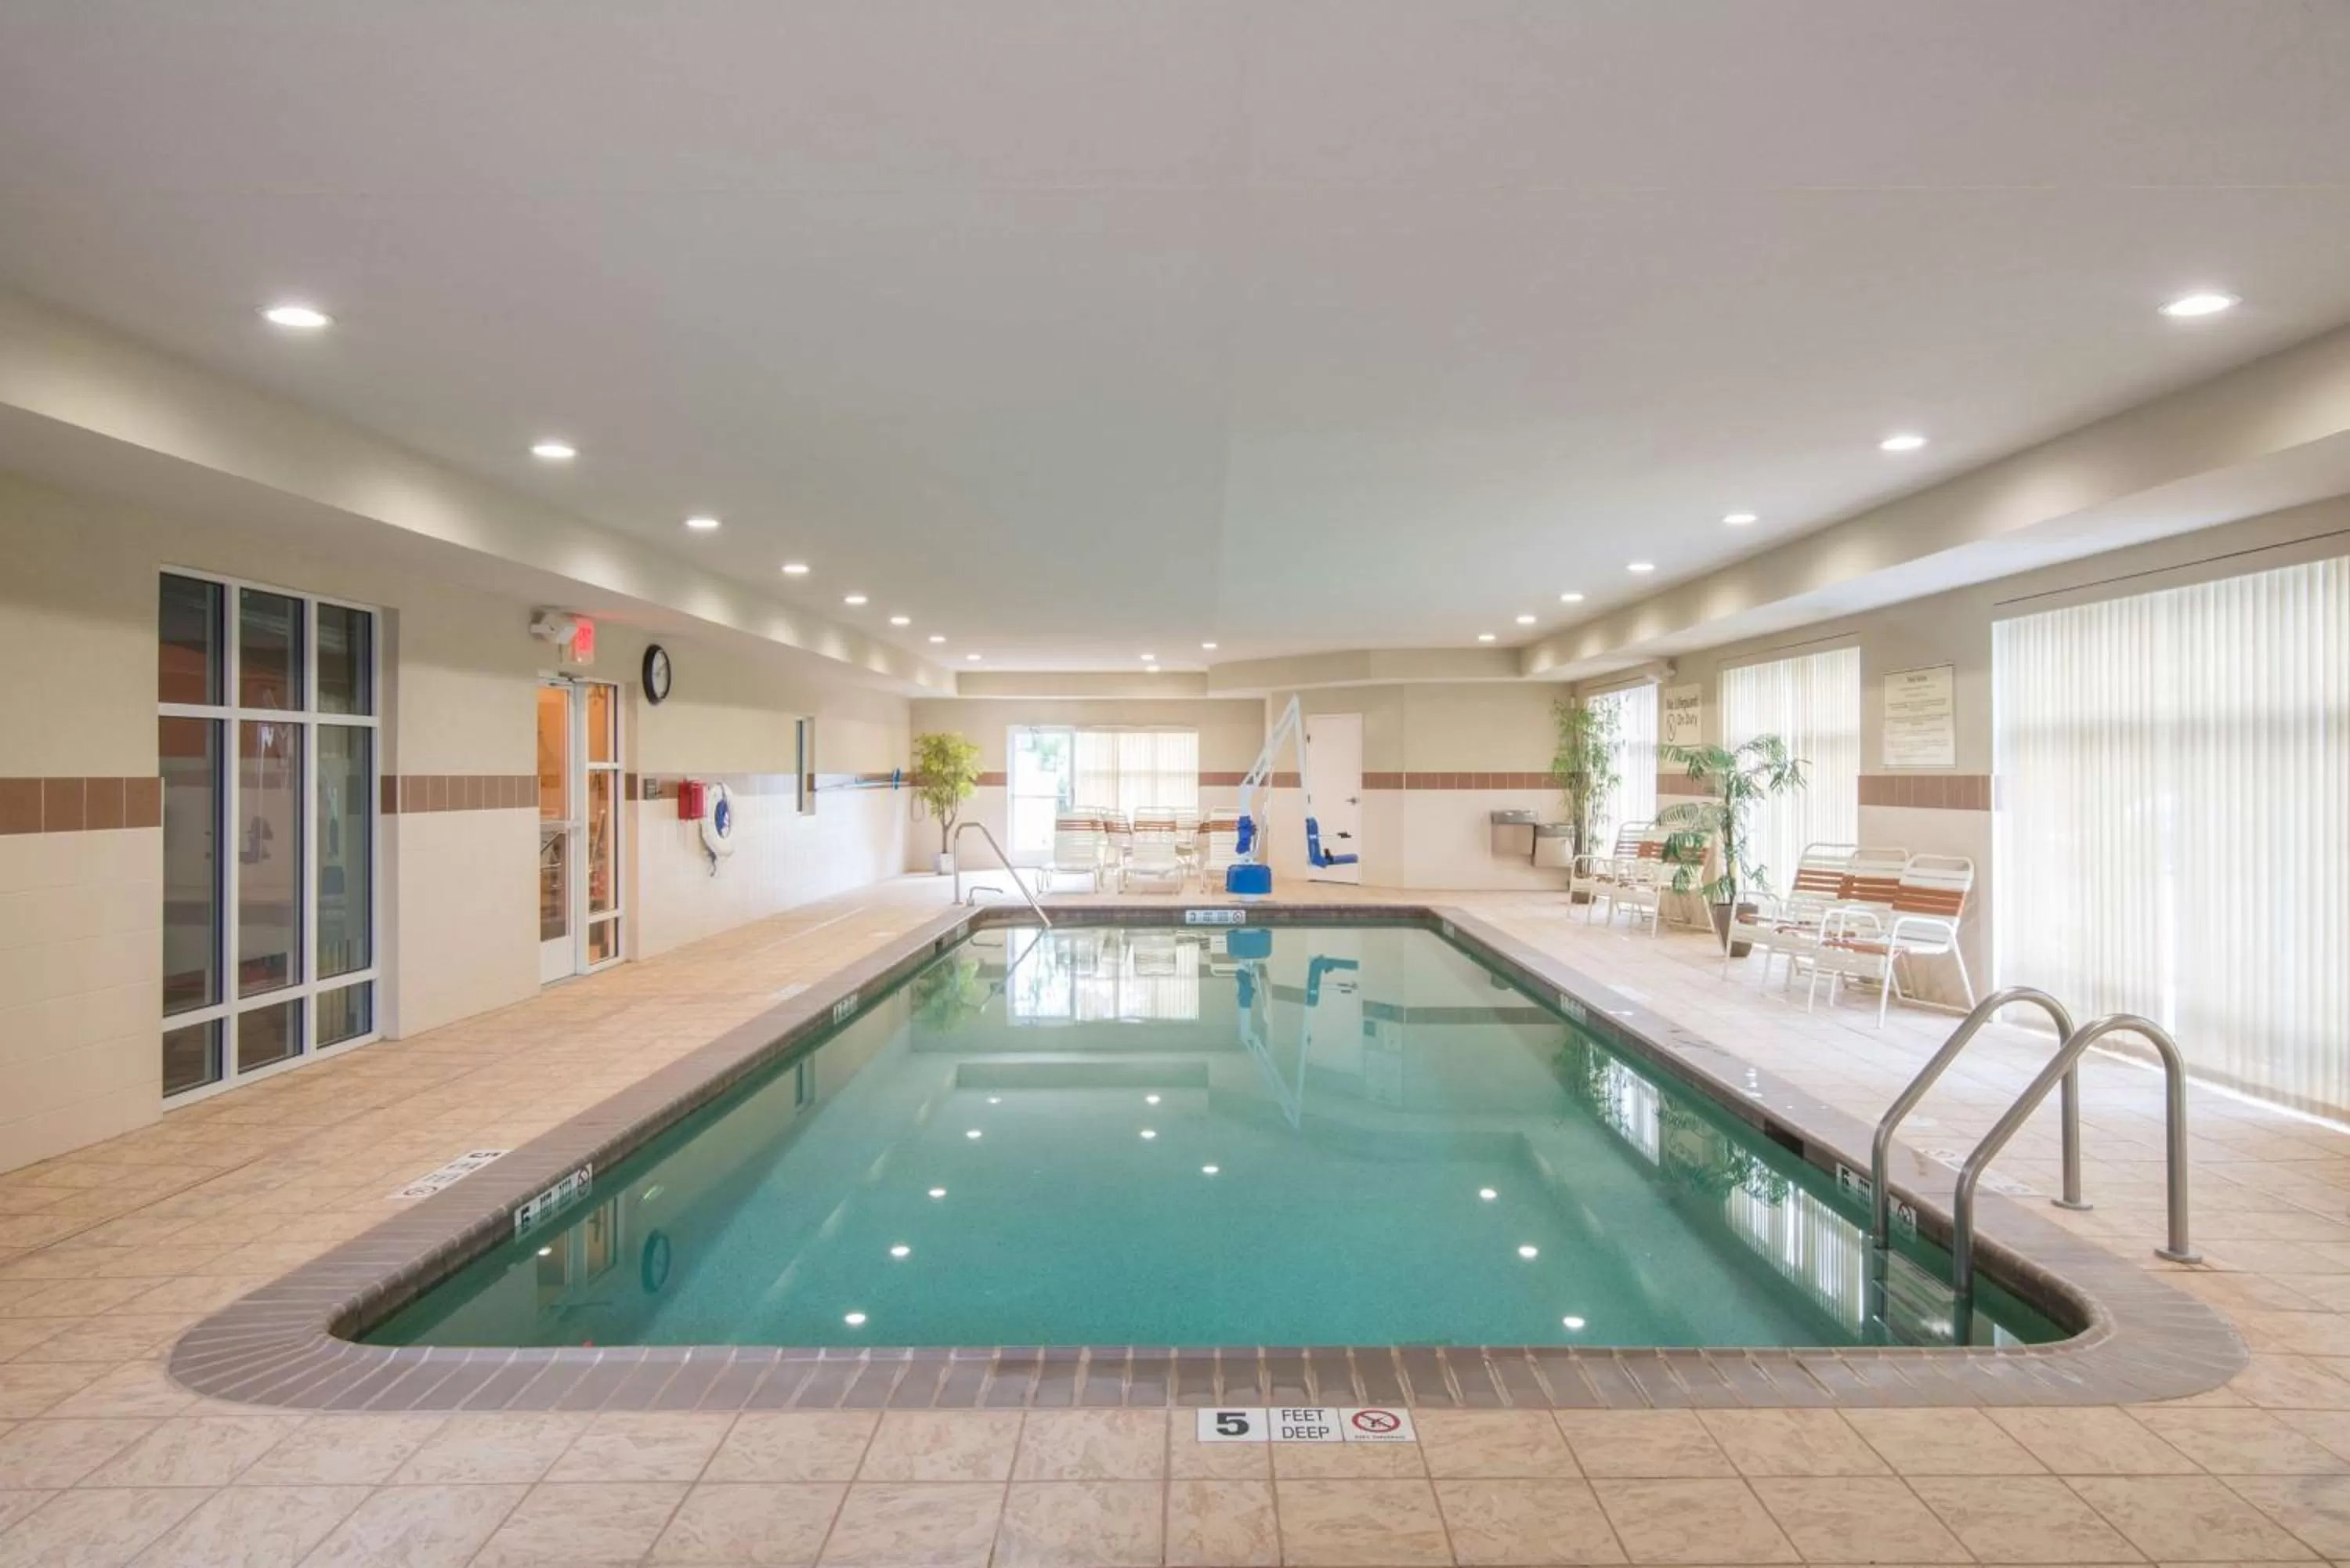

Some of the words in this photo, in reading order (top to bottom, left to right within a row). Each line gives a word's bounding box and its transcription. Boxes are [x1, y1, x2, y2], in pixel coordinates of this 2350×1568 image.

[1282, 1409, 1325, 1422] FEET
[1216, 1411, 1250, 1436] 5
[1282, 1426, 1329, 1439] DEEP
